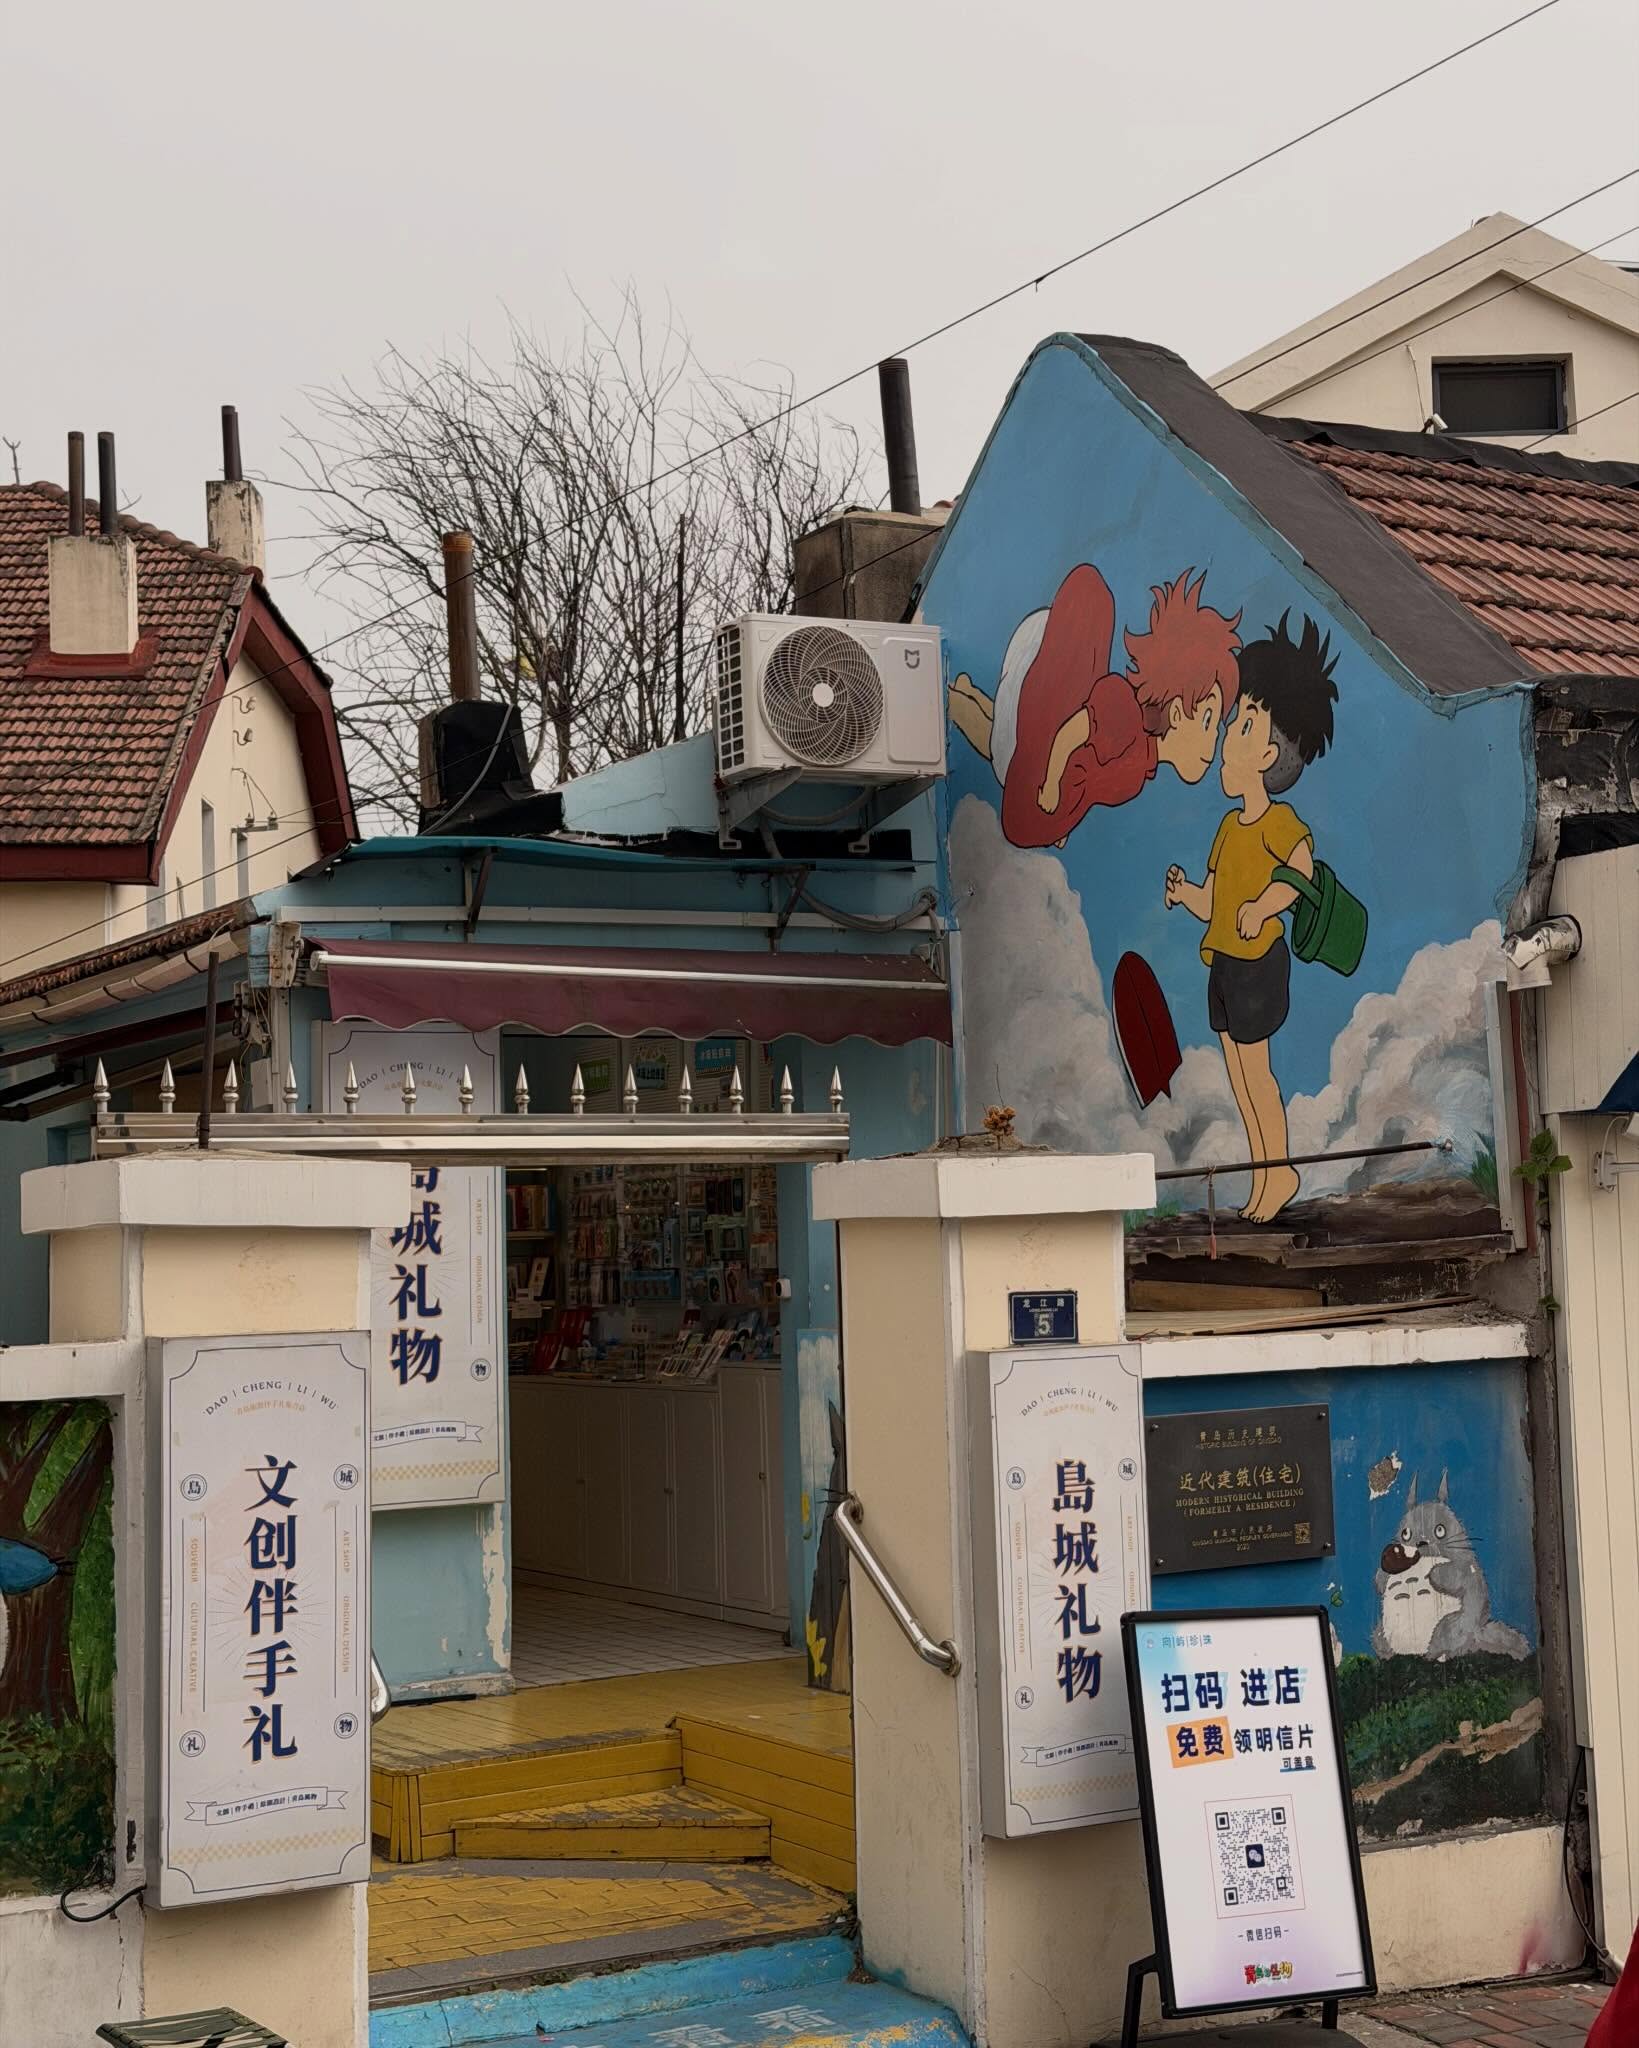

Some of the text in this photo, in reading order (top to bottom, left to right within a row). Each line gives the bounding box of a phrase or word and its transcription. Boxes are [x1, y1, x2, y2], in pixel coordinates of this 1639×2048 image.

[1038, 1313, 1050, 1335] 5
[475, 1363, 487, 1376] 物
[205, 1395, 228, 1415] DAO
[242, 1381, 282, 1393] CHENG
[297, 1384, 308, 1395] LI
[320, 1395, 337, 1410] WU
[1021, 1400, 1038, 1416] DAO
[1048, 1388, 1076, 1398] CHENG
[1088, 1390, 1096, 1399] LI
[1105, 1400, 1118, 1412] WU
[340, 1470, 353, 1484] 城
[1122, 1463, 1133, 1475] 城
[1179, 1463, 1301, 1492] 近代建筑(住宅)
[188, 1481, 201, 1495] 島
[1176, 1488, 1304, 1507] MODERN HISTORICAL BUILDING
[343, 1549, 351, 1573] SHOP
[1052, 1460, 1102, 1703] 島城礼物
[189, 1538, 198, 1692] SOUVENIR CULTURAL CREATIVE
[243, 1454, 299, 1762] 文创伴手礼
[342, 1641, 350, 1673] DESIGN
[1020, 1691, 1030, 1704] 礼
[1161, 1666, 1301, 1713] 扫码 进店
[339, 1719, 352, 1733] 物
[186, 1737, 199, 1752] 礼
[1176, 1724, 1313, 1758] 免费 领明信片
[1282, 1755, 1315, 1770] 可盖章
